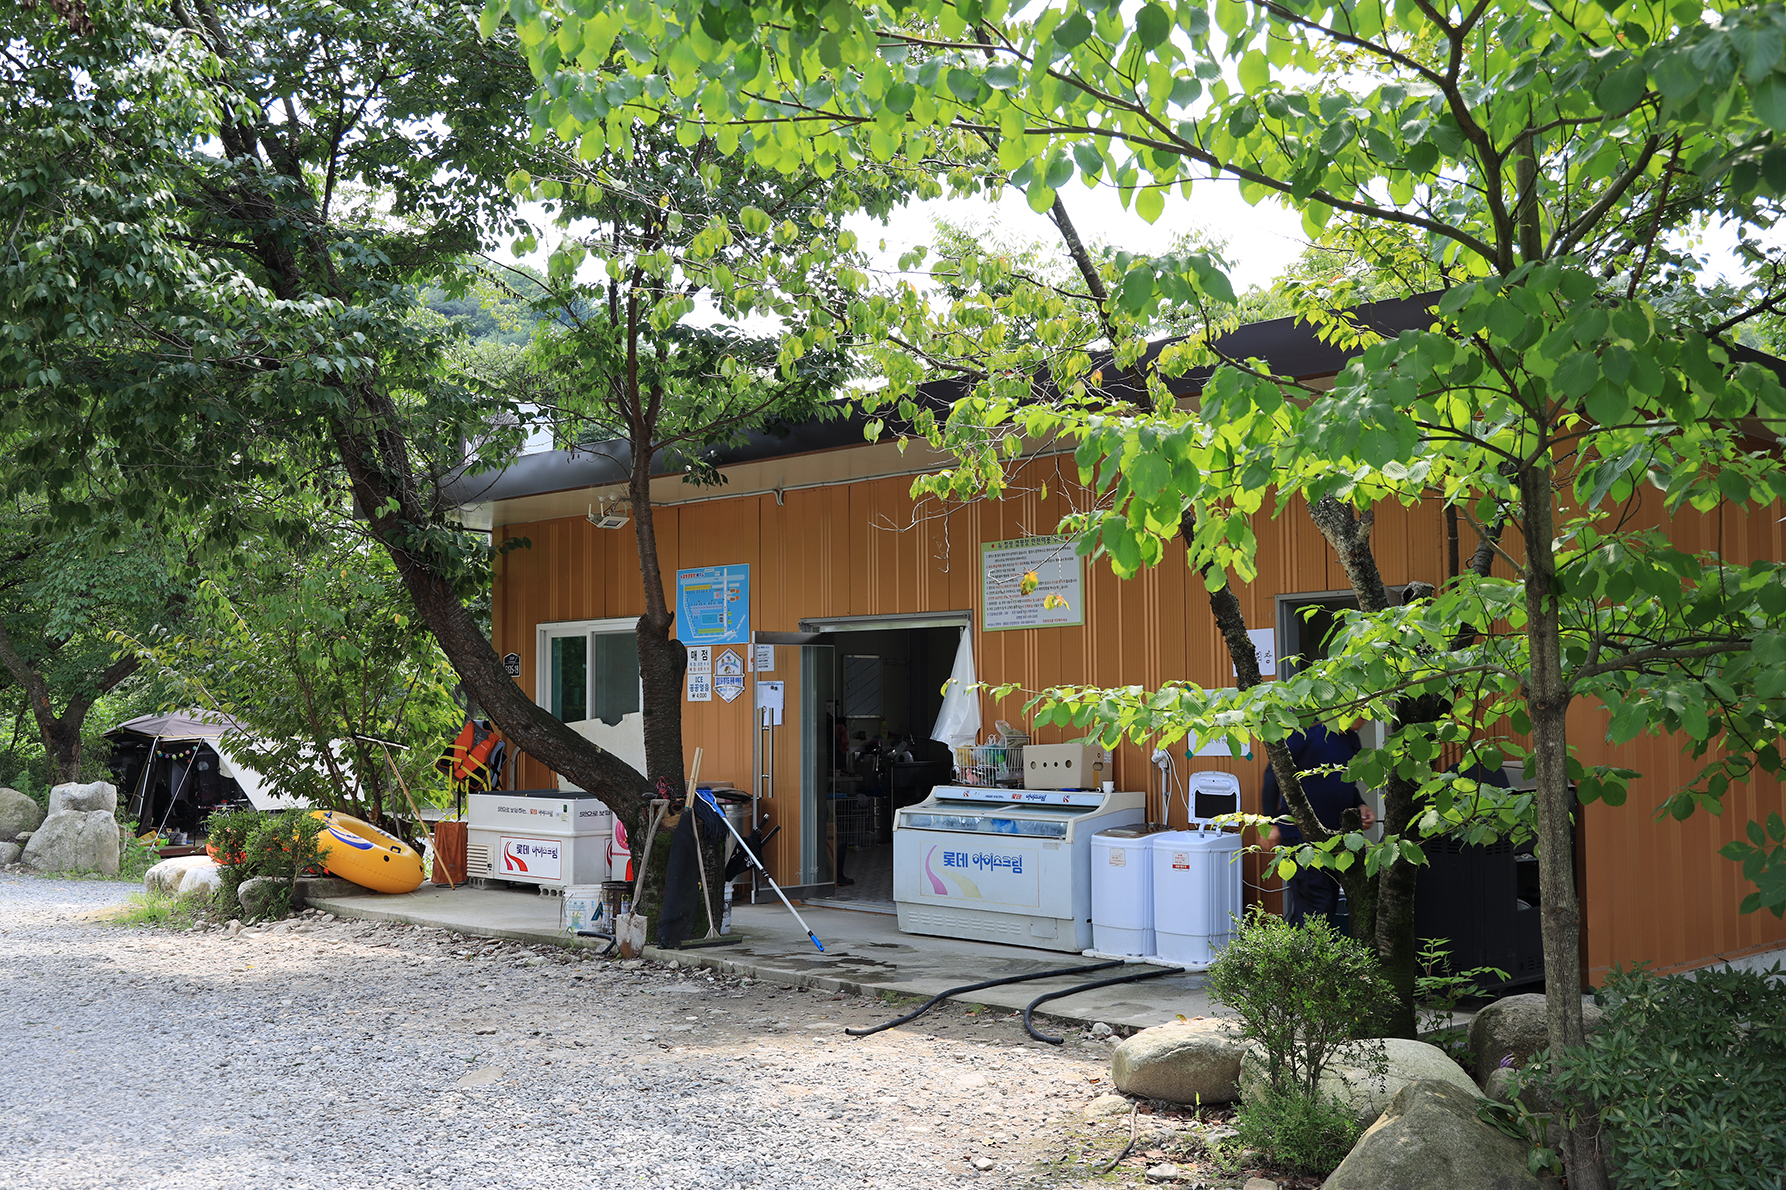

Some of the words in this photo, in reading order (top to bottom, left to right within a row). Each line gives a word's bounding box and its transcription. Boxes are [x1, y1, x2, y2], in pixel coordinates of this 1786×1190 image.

[1015, 538, 1030, 548] 캠핑장
[1031, 535, 1052, 546] 안전이용
[516, 843, 530, 855] 롯데
[531, 845, 558, 859] 아이스크림
[943, 851, 969, 868] 롯데
[972, 851, 1023, 874] 아이스크림
